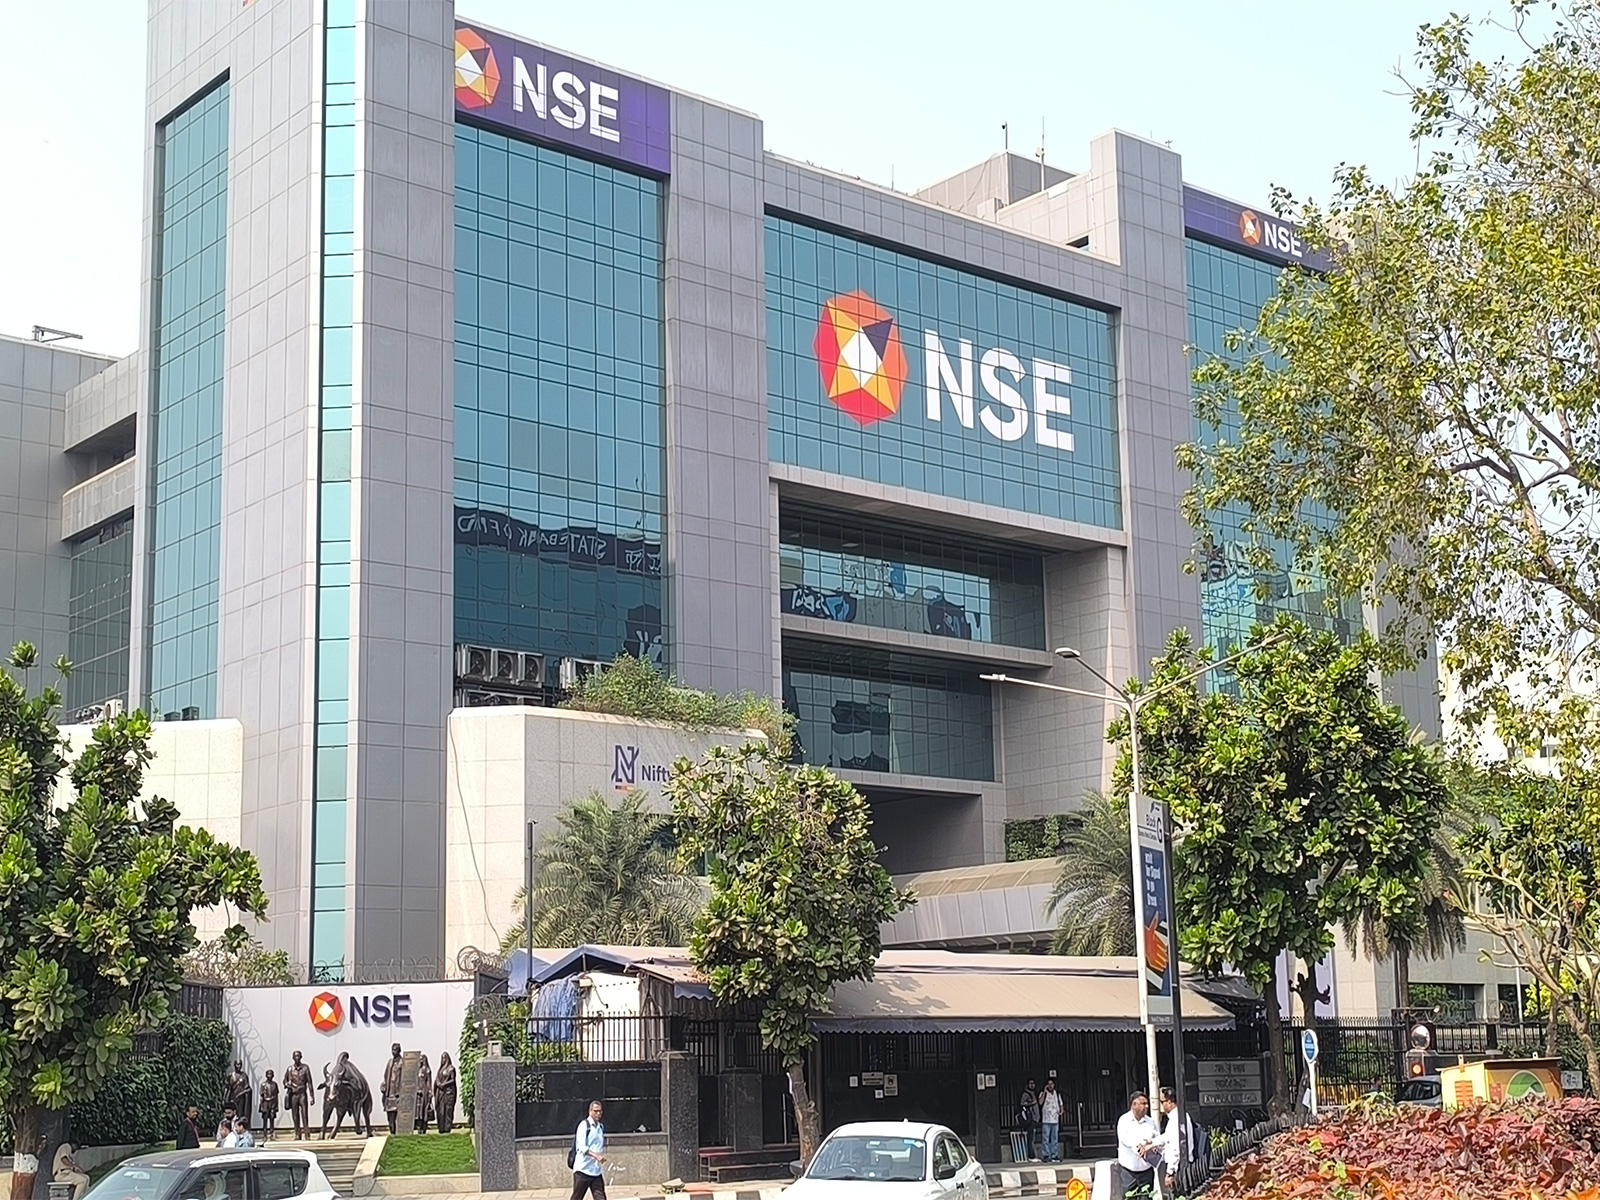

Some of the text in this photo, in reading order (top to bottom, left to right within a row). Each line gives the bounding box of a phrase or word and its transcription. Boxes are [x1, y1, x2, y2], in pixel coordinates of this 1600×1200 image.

[512, 56, 621, 143] NSE
[1264, 221, 1303, 257] NSE
[924, 328, 1075, 452] NSE
[1157, 817, 1163, 844] G
[349, 994, 411, 1025] NSE
